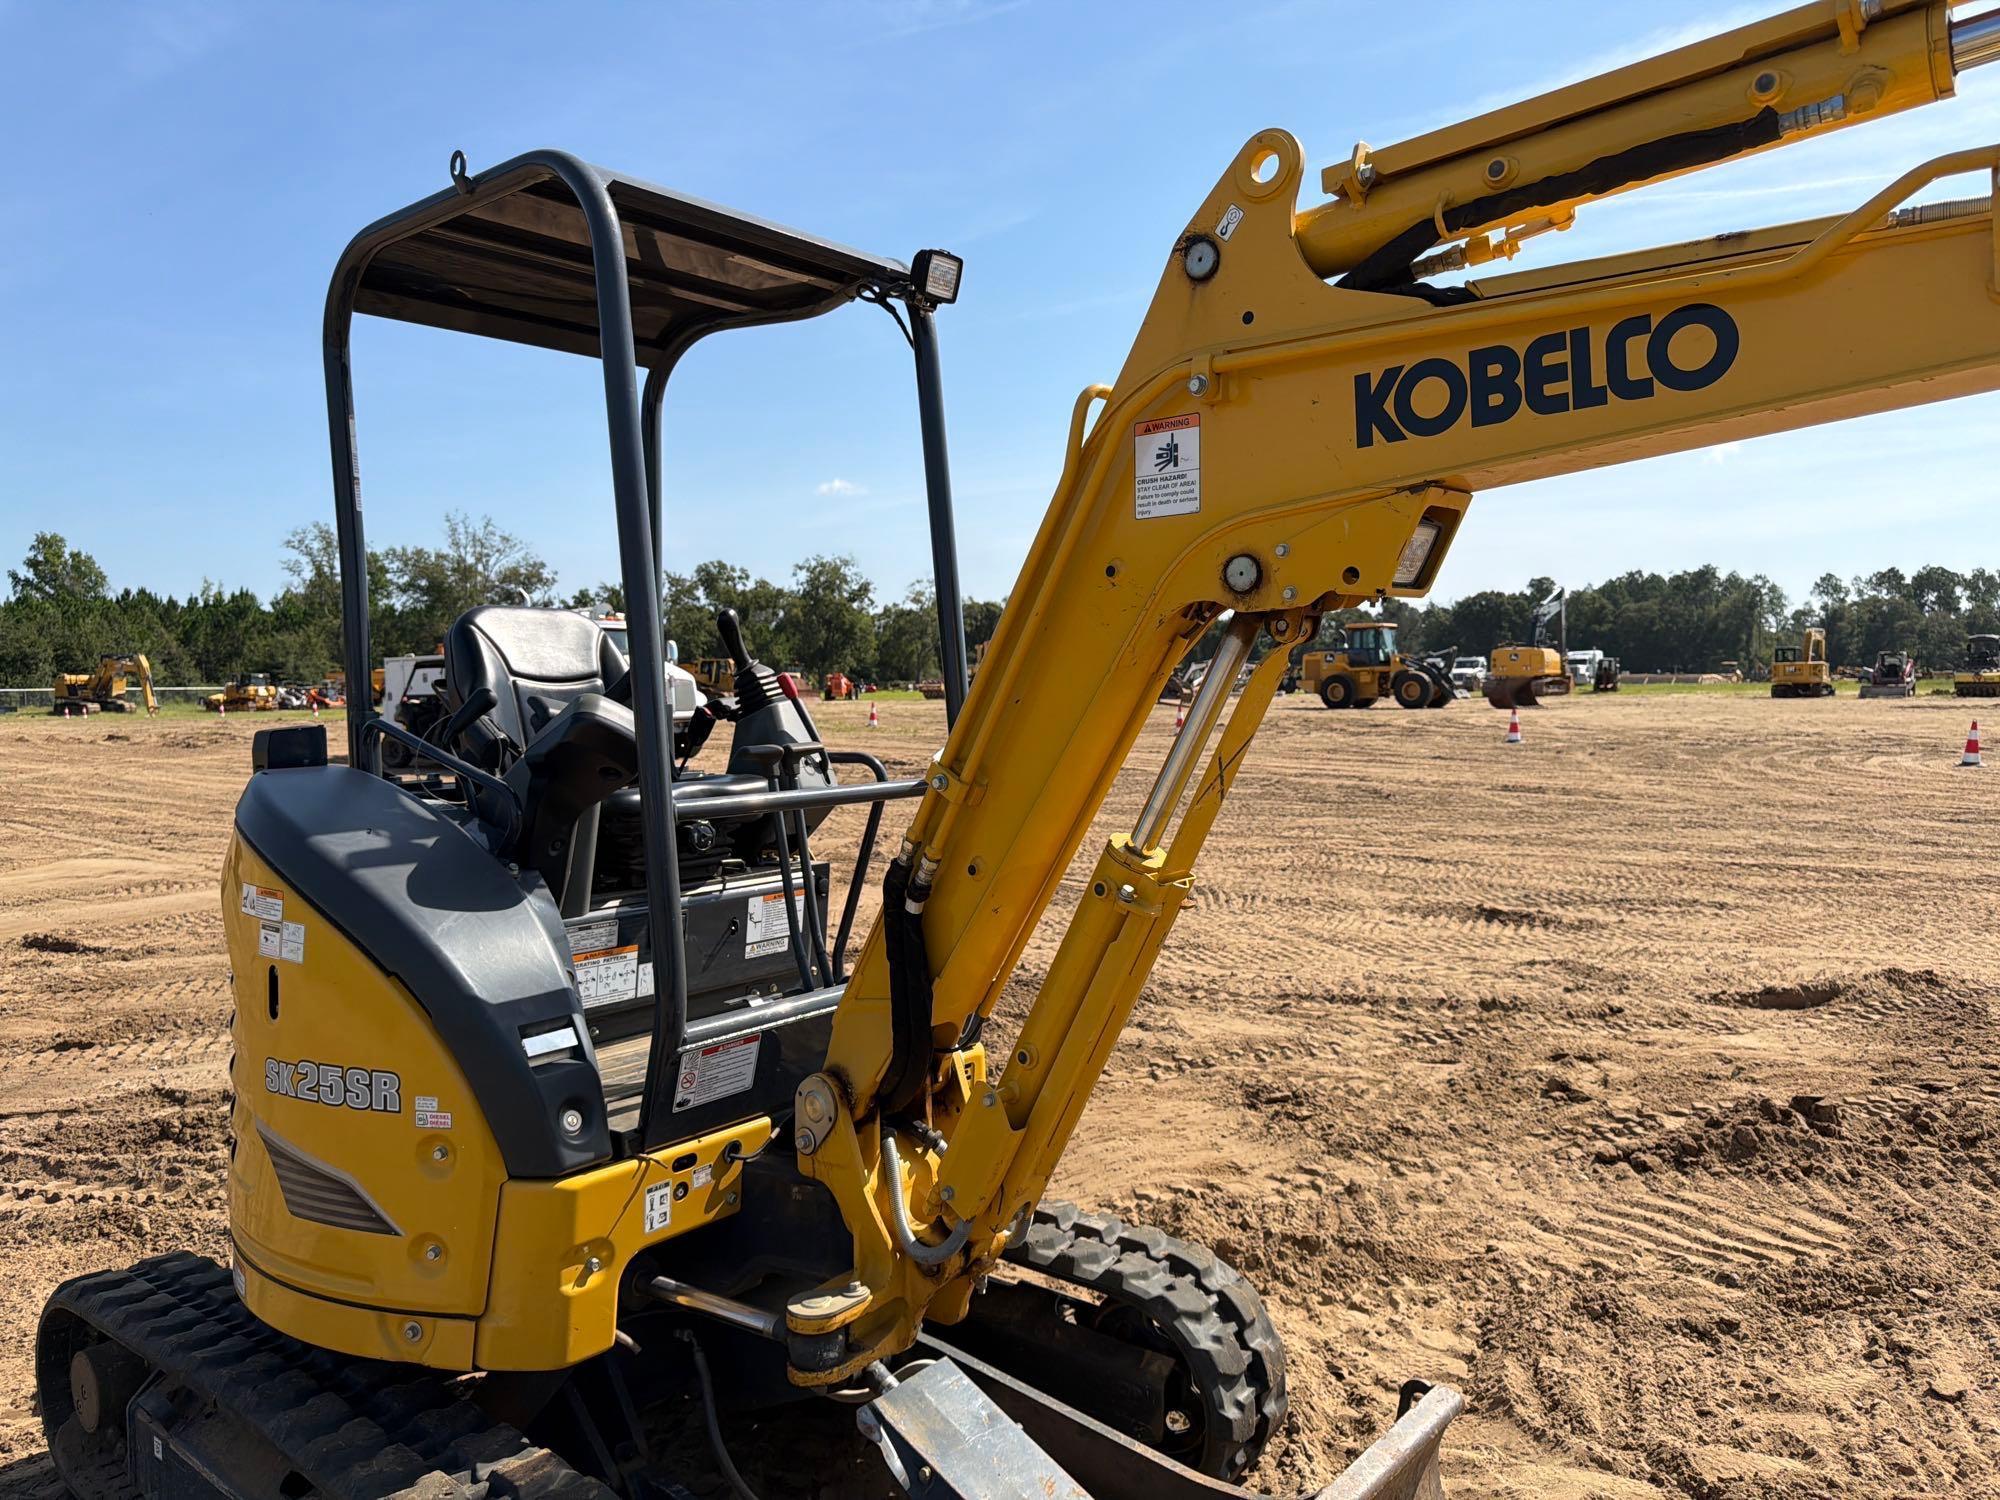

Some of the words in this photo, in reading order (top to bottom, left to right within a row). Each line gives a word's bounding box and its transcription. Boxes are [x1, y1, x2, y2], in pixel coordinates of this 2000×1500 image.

[1353, 302, 1740, 449] KOBELCO
[1151, 418, 1190, 432] WARNING
[1137, 476, 1159, 486] CRUSH
[1159, 473, 1187, 483] HAZARD!
[1137, 485, 1151, 493] STAY
[1151, 482, 1170, 491] CLEAR
[1179, 480, 1196, 488] AREA!
[1137, 493, 1154, 501] Failure
[1160, 490, 1180, 499] comply
[1157, 498, 1172, 506] death
[1137, 508, 1151, 517] injury
[756, 939, 785, 950] WARNING
[575, 960, 601, 968] ERATING
[602, 955, 628, 964] PATTERN
[265, 1057, 401, 1113] SK25SR
